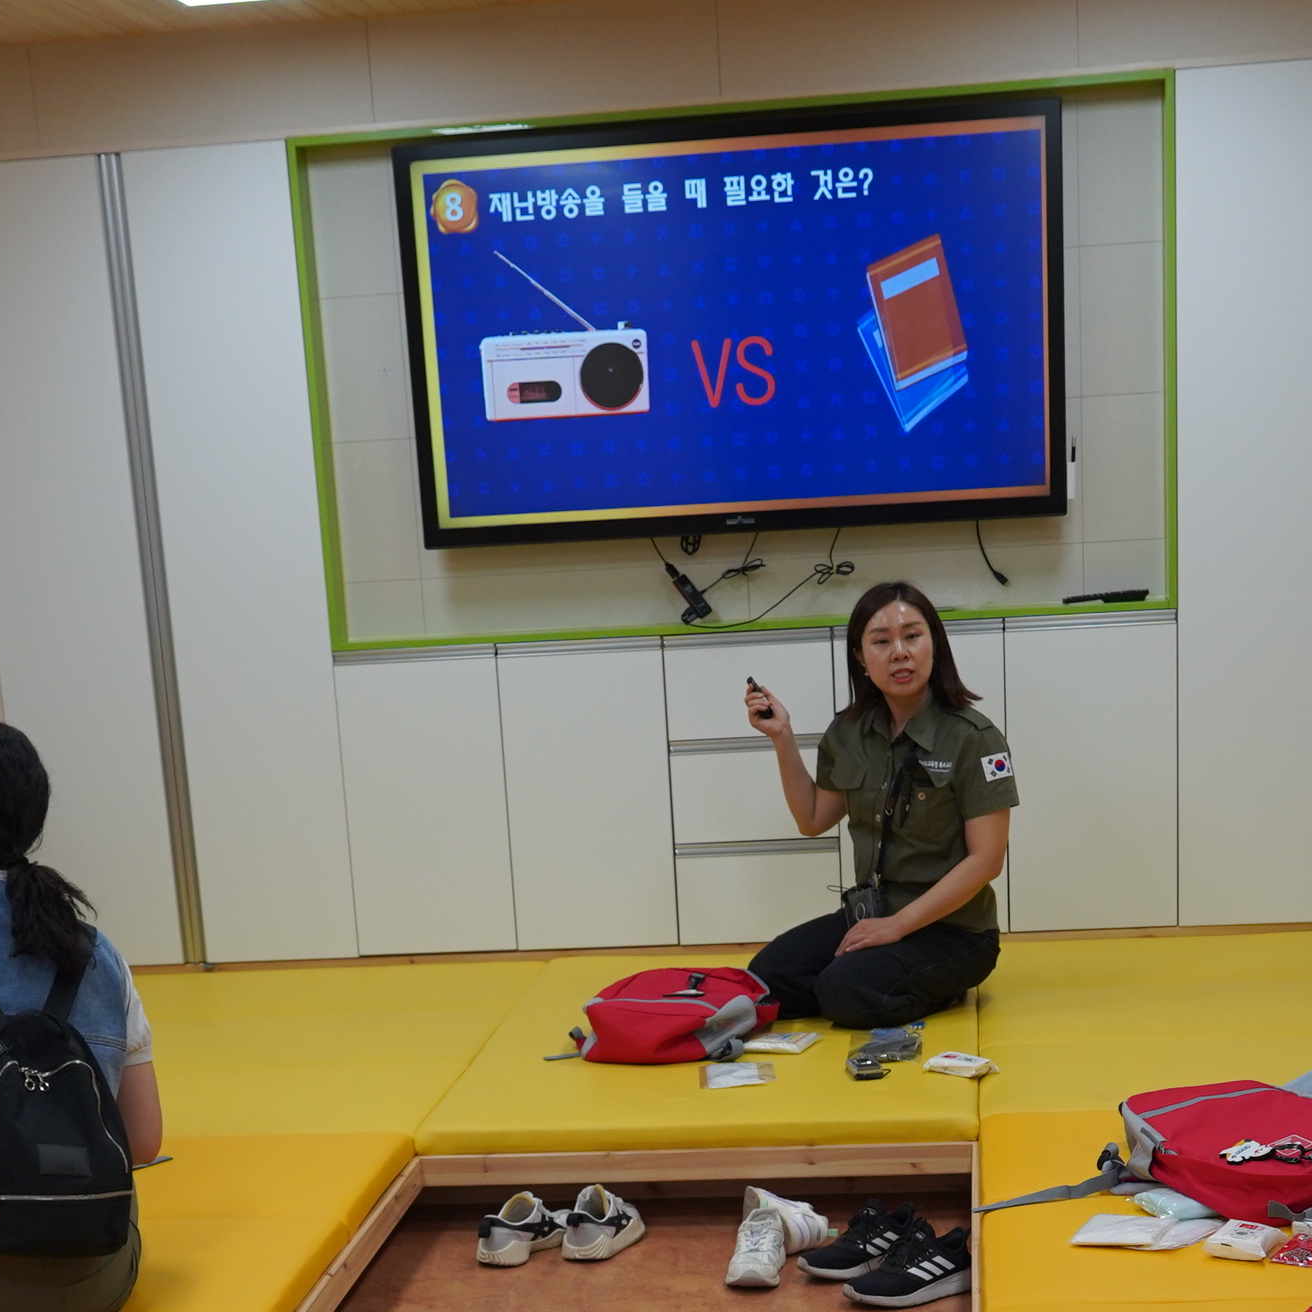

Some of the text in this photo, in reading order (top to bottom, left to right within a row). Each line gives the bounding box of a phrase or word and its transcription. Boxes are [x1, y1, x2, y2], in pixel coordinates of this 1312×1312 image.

[444, 166, 874, 223] 8 재난방송을 들을 때 필요한 것은?
[690, 335, 777, 409] VS
